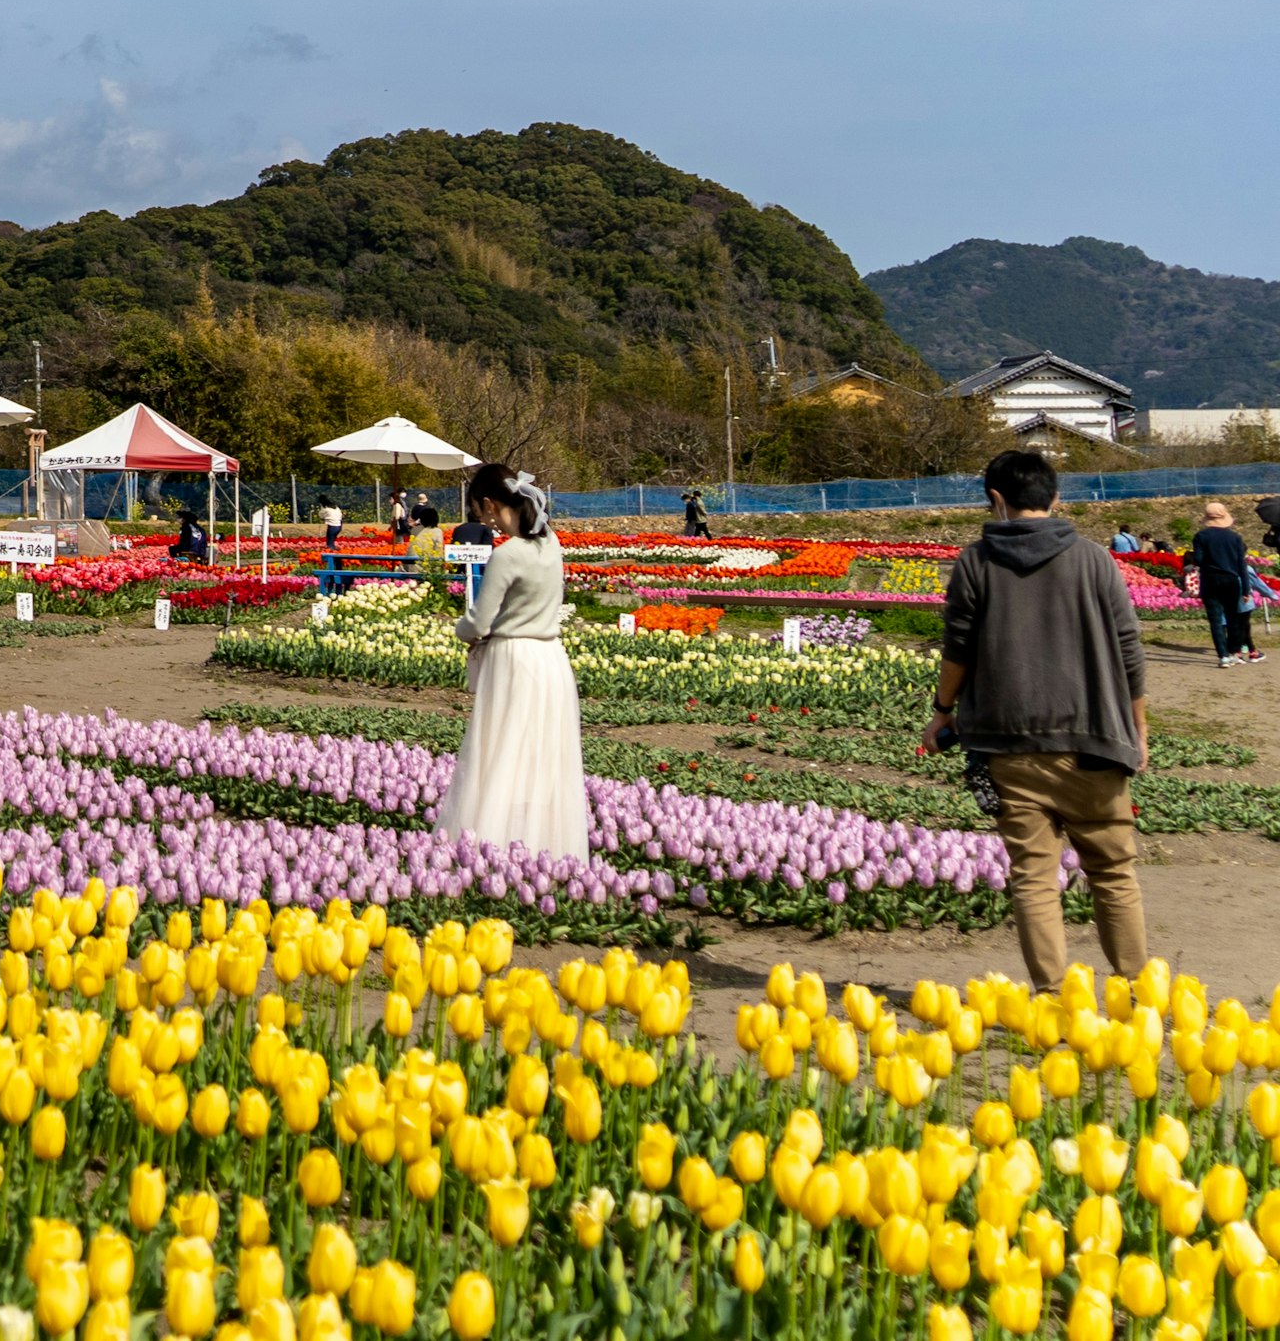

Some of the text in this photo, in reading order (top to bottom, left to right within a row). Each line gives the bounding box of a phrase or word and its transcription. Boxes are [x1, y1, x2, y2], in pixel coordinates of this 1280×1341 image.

[49, 455, 122, 466] かがみ花フェスタ
